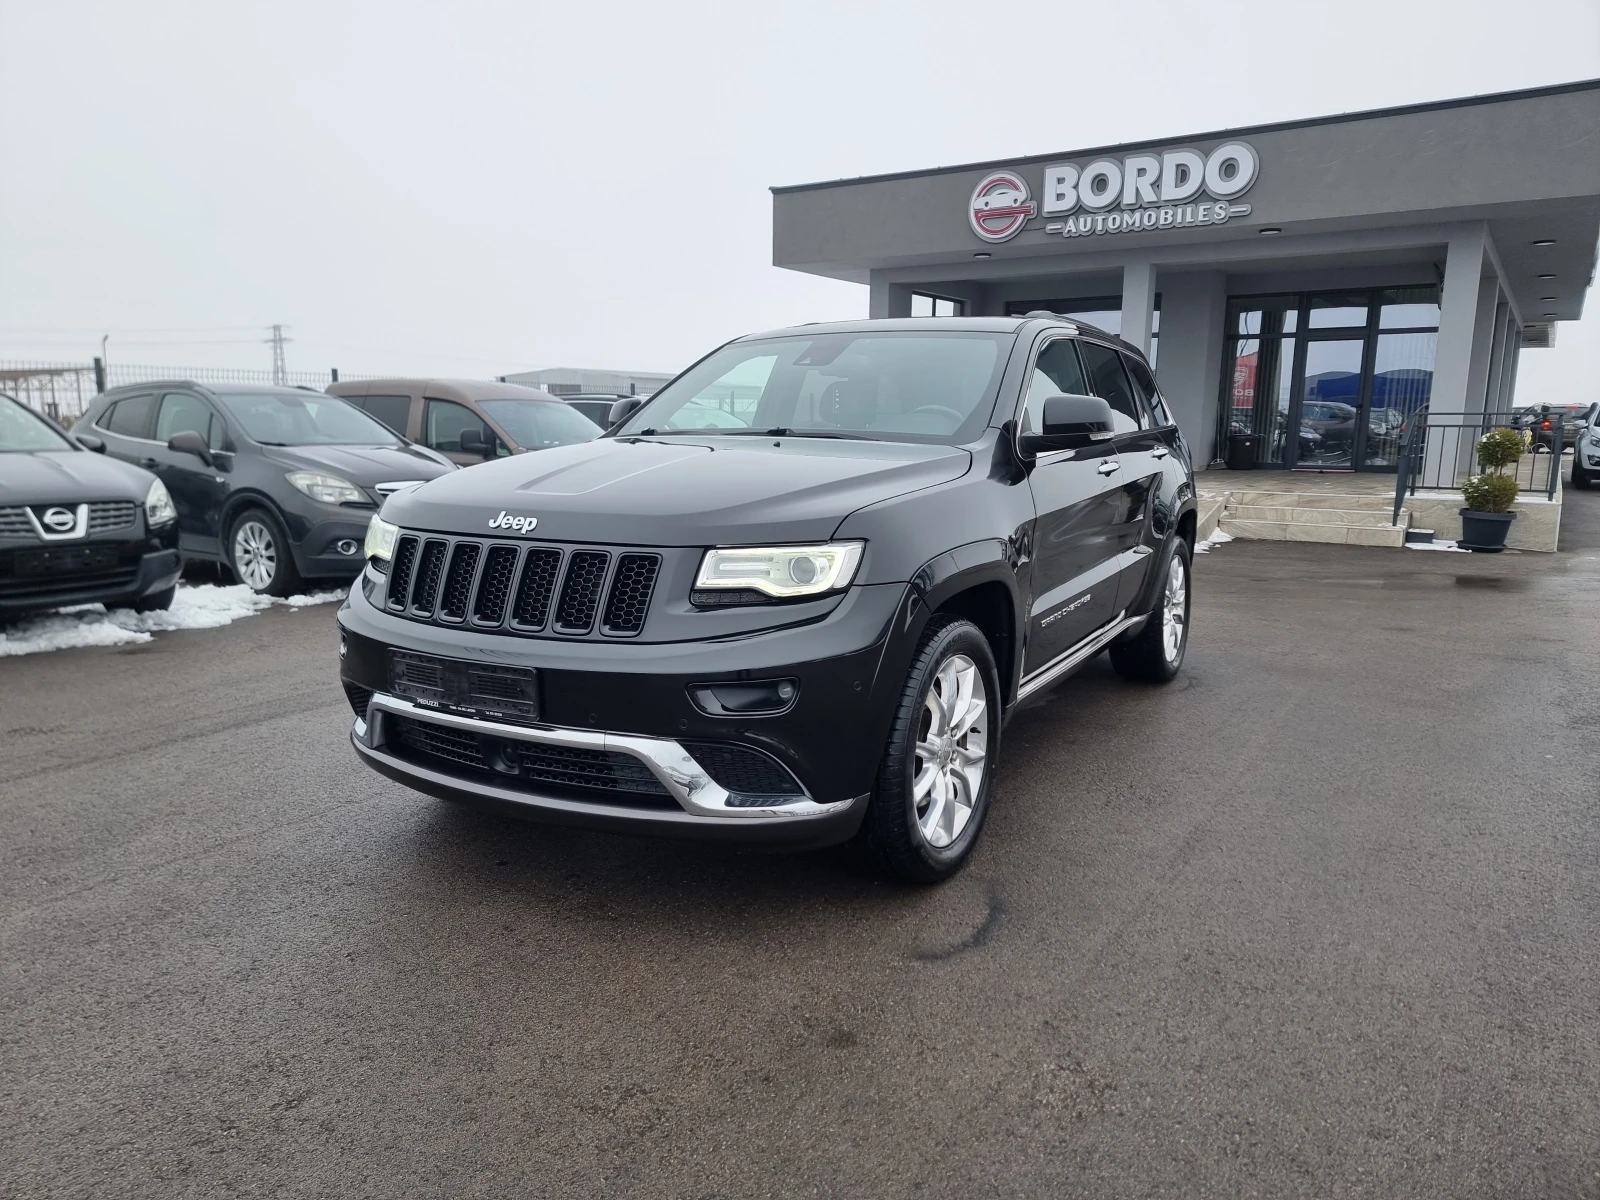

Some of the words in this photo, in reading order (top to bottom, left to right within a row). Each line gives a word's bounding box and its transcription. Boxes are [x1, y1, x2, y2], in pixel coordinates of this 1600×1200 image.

[1043, 144, 1255, 213] BORDO
[1064, 203, 1227, 234] AUTOMOBILES
[488, 510, 538, 535] Jeep
